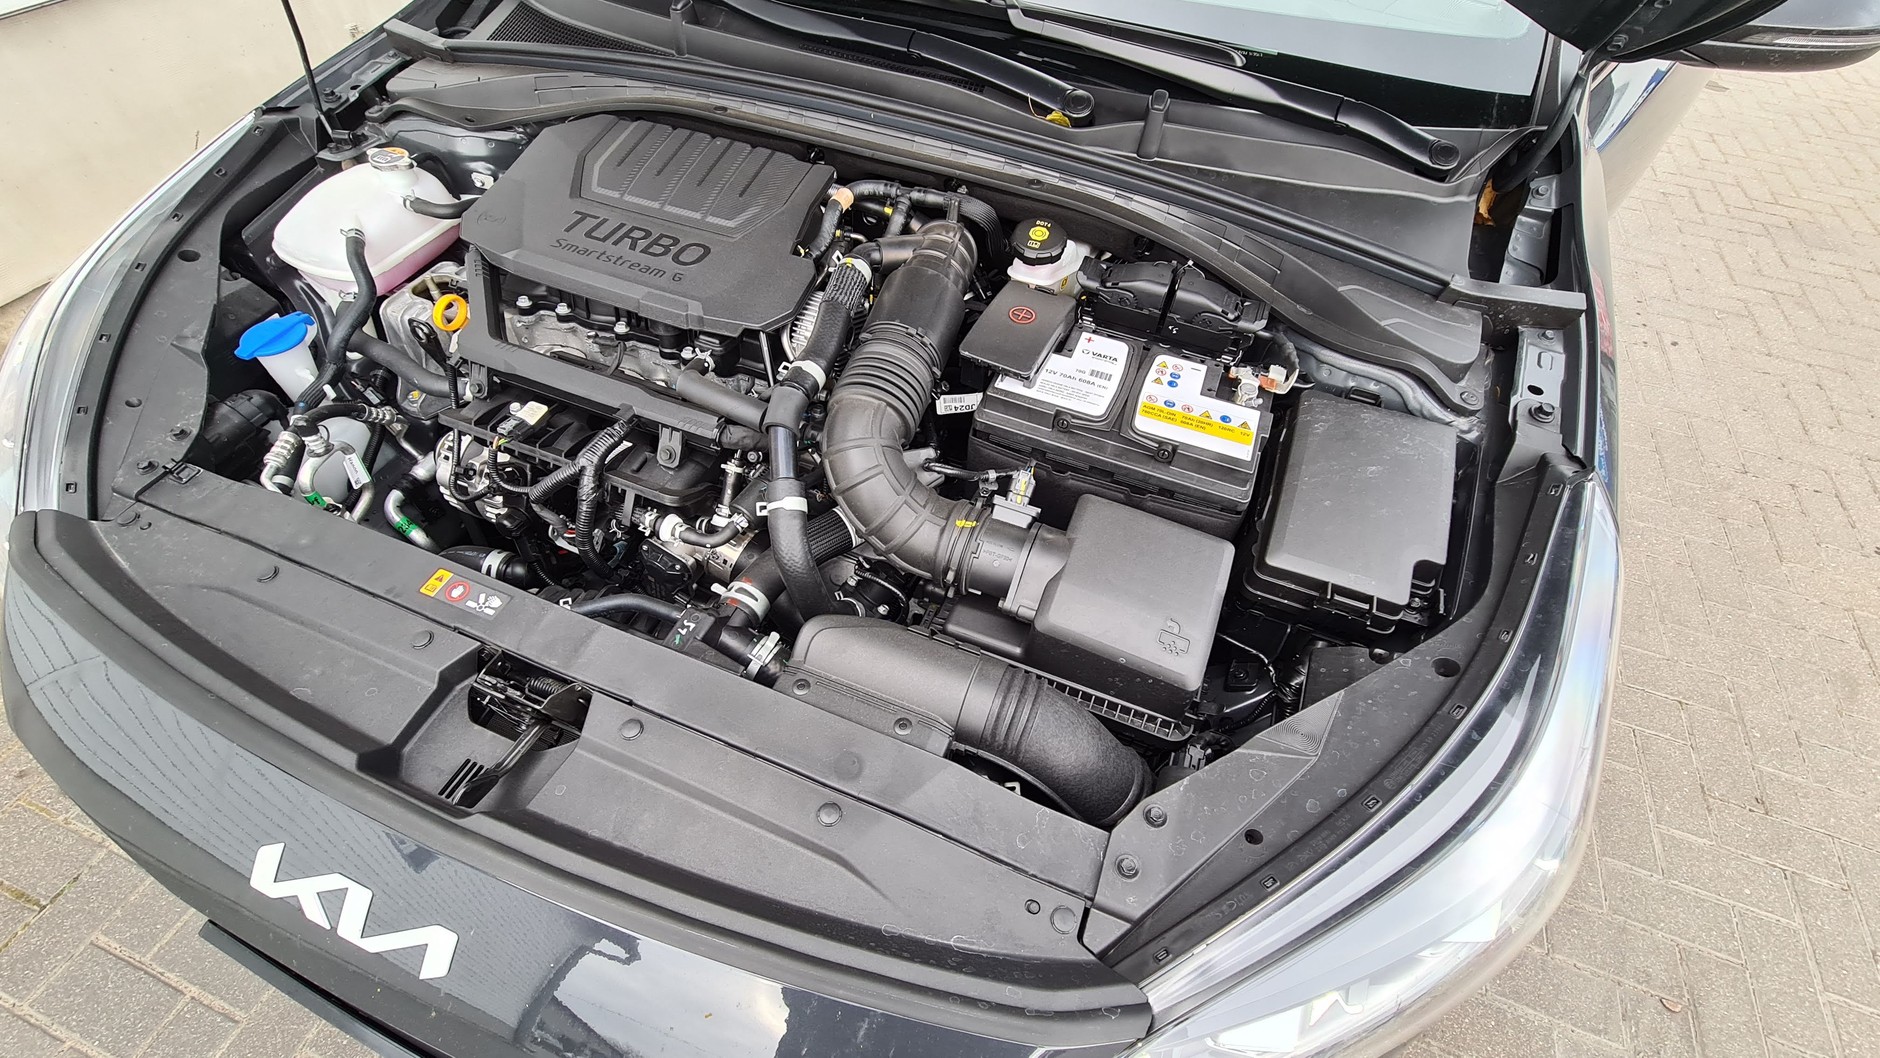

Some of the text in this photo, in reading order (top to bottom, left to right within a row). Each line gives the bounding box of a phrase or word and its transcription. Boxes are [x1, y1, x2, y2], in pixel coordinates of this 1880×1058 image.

[562, 210, 712, 266] TURBO
[550, 238, 684, 282] Smartstream G
[1091, 351, 1118, 362] VARTA
[1059, 373, 1077, 381] 70Ah
